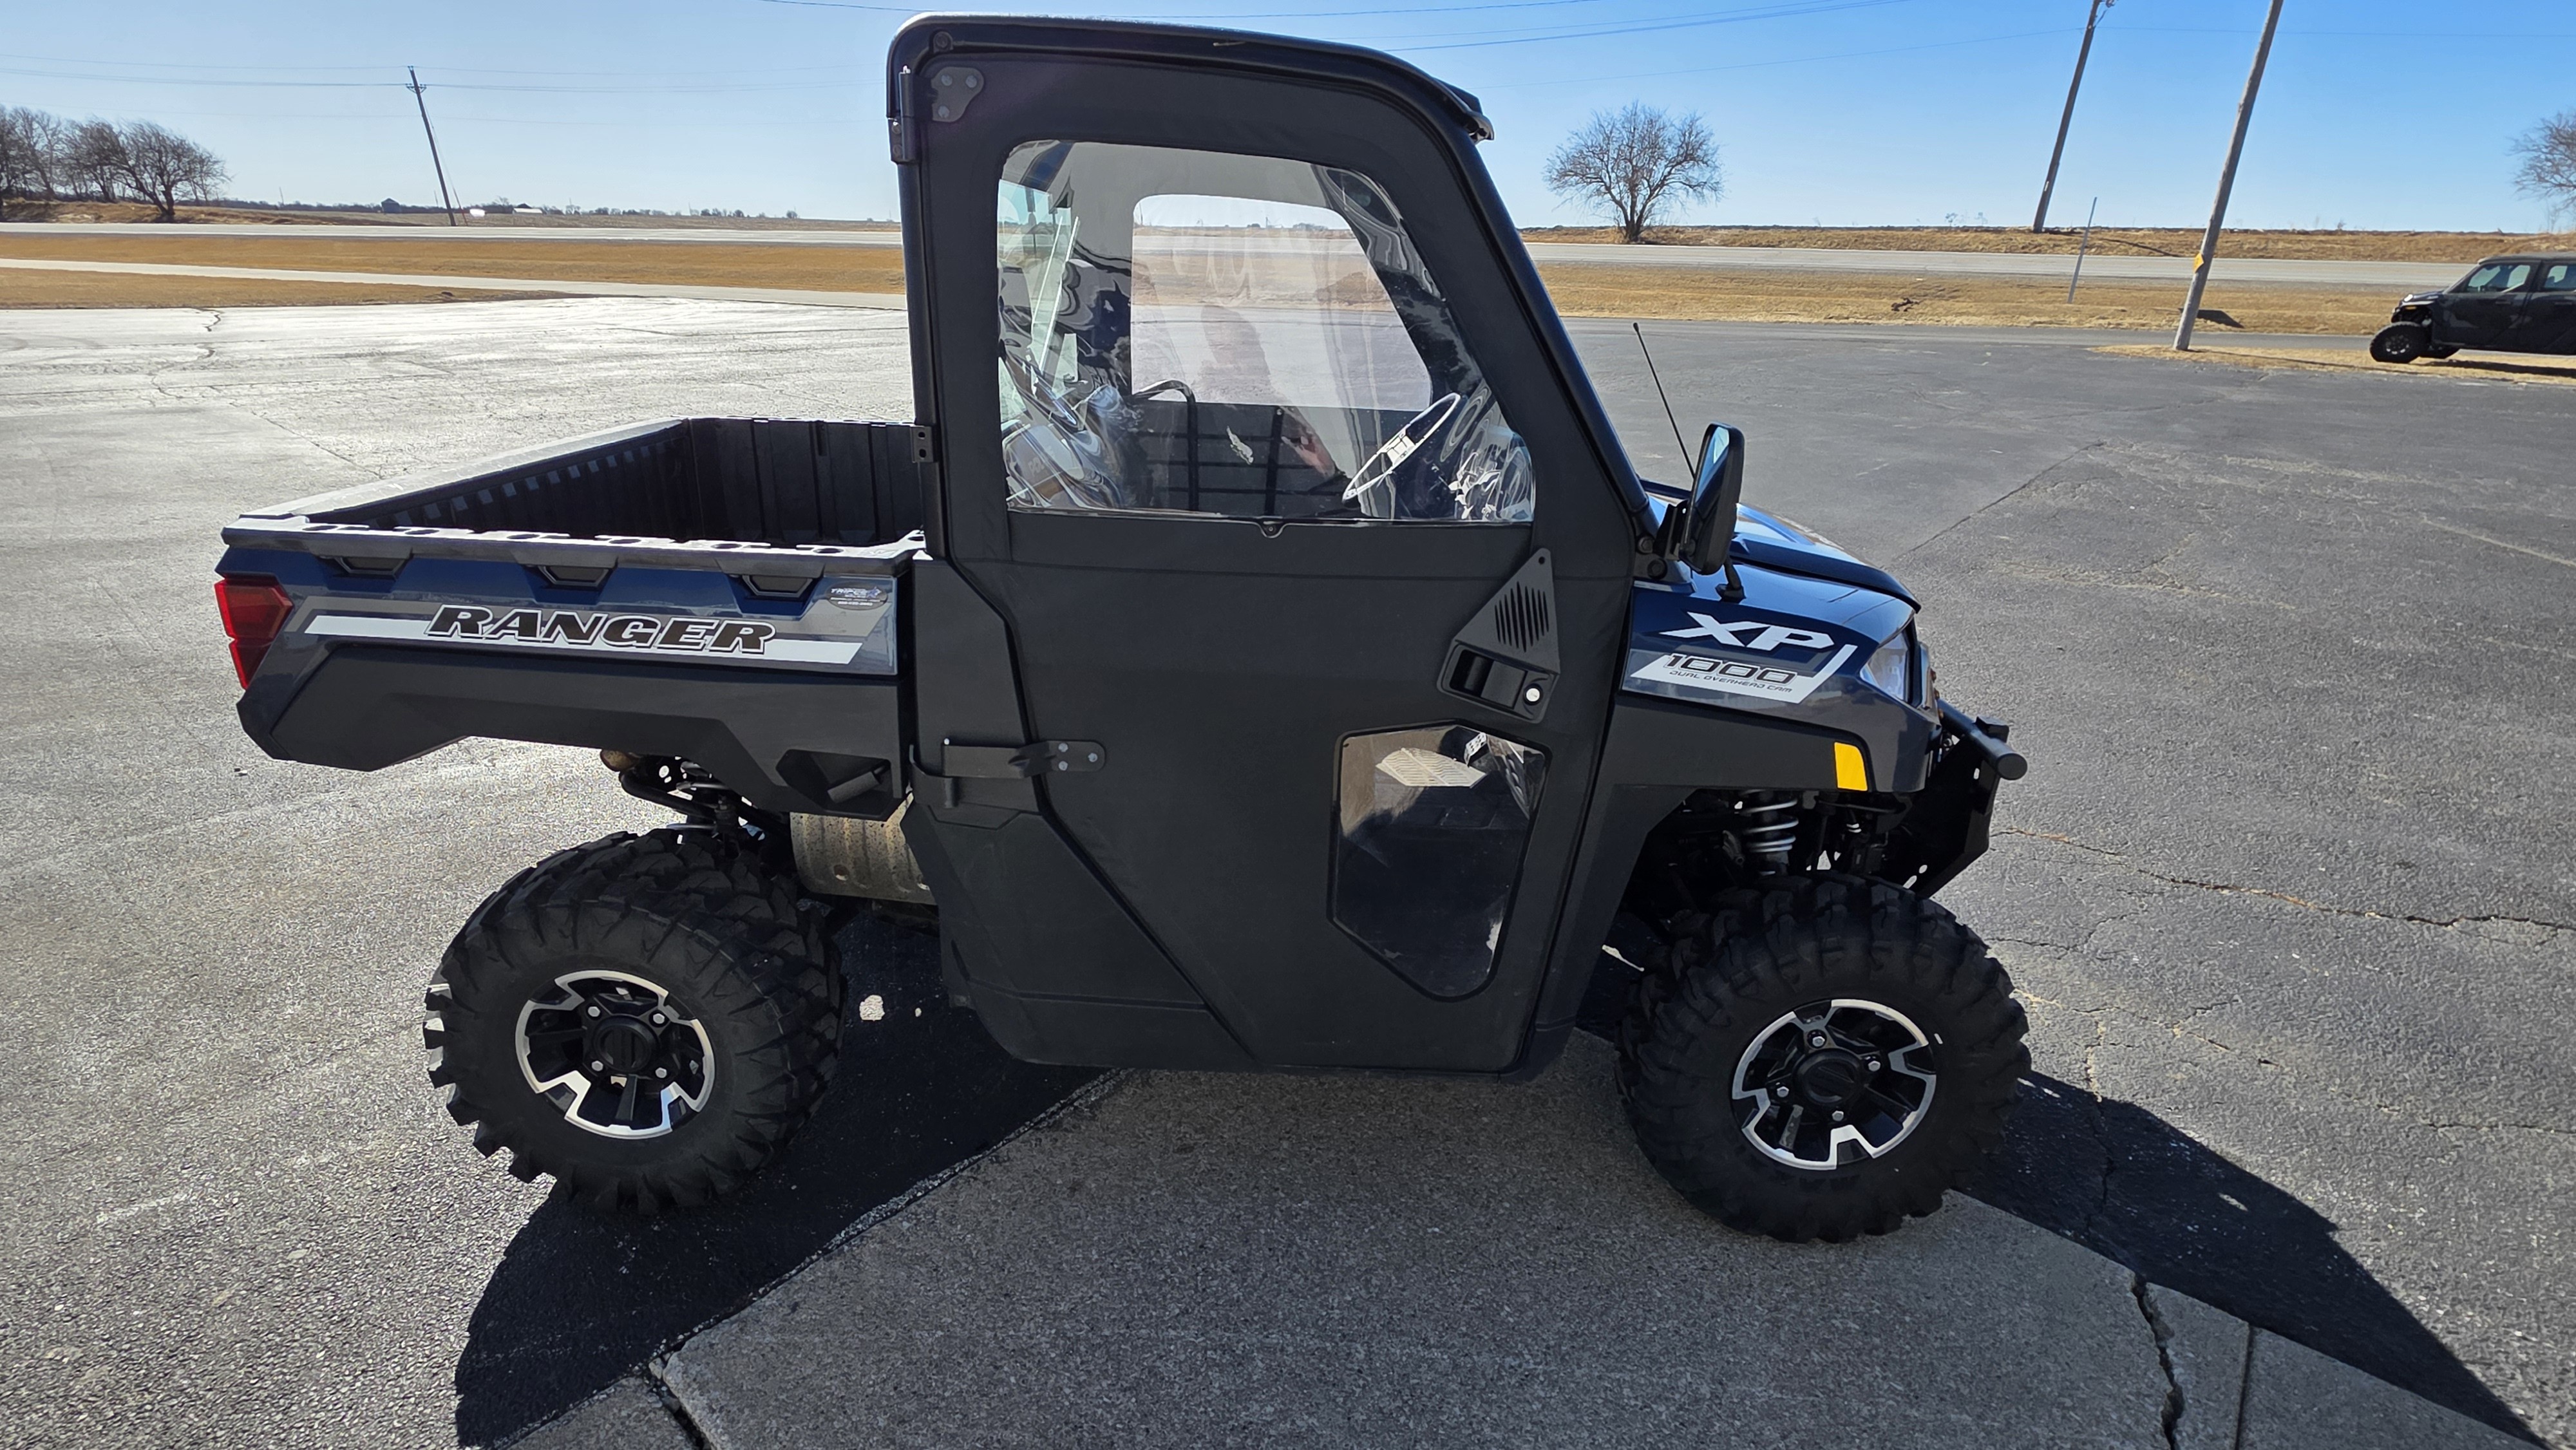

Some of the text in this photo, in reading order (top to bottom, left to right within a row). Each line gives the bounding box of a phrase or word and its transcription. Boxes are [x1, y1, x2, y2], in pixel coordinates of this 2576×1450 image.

[425, 605, 775, 654] RANGER
[1659, 611, 1835, 650] XP
[1664, 654, 1797, 684] 1000
[1669, 670, 1700, 679] DUAL
[1703, 676, 1765, 689] OVERHEAD
